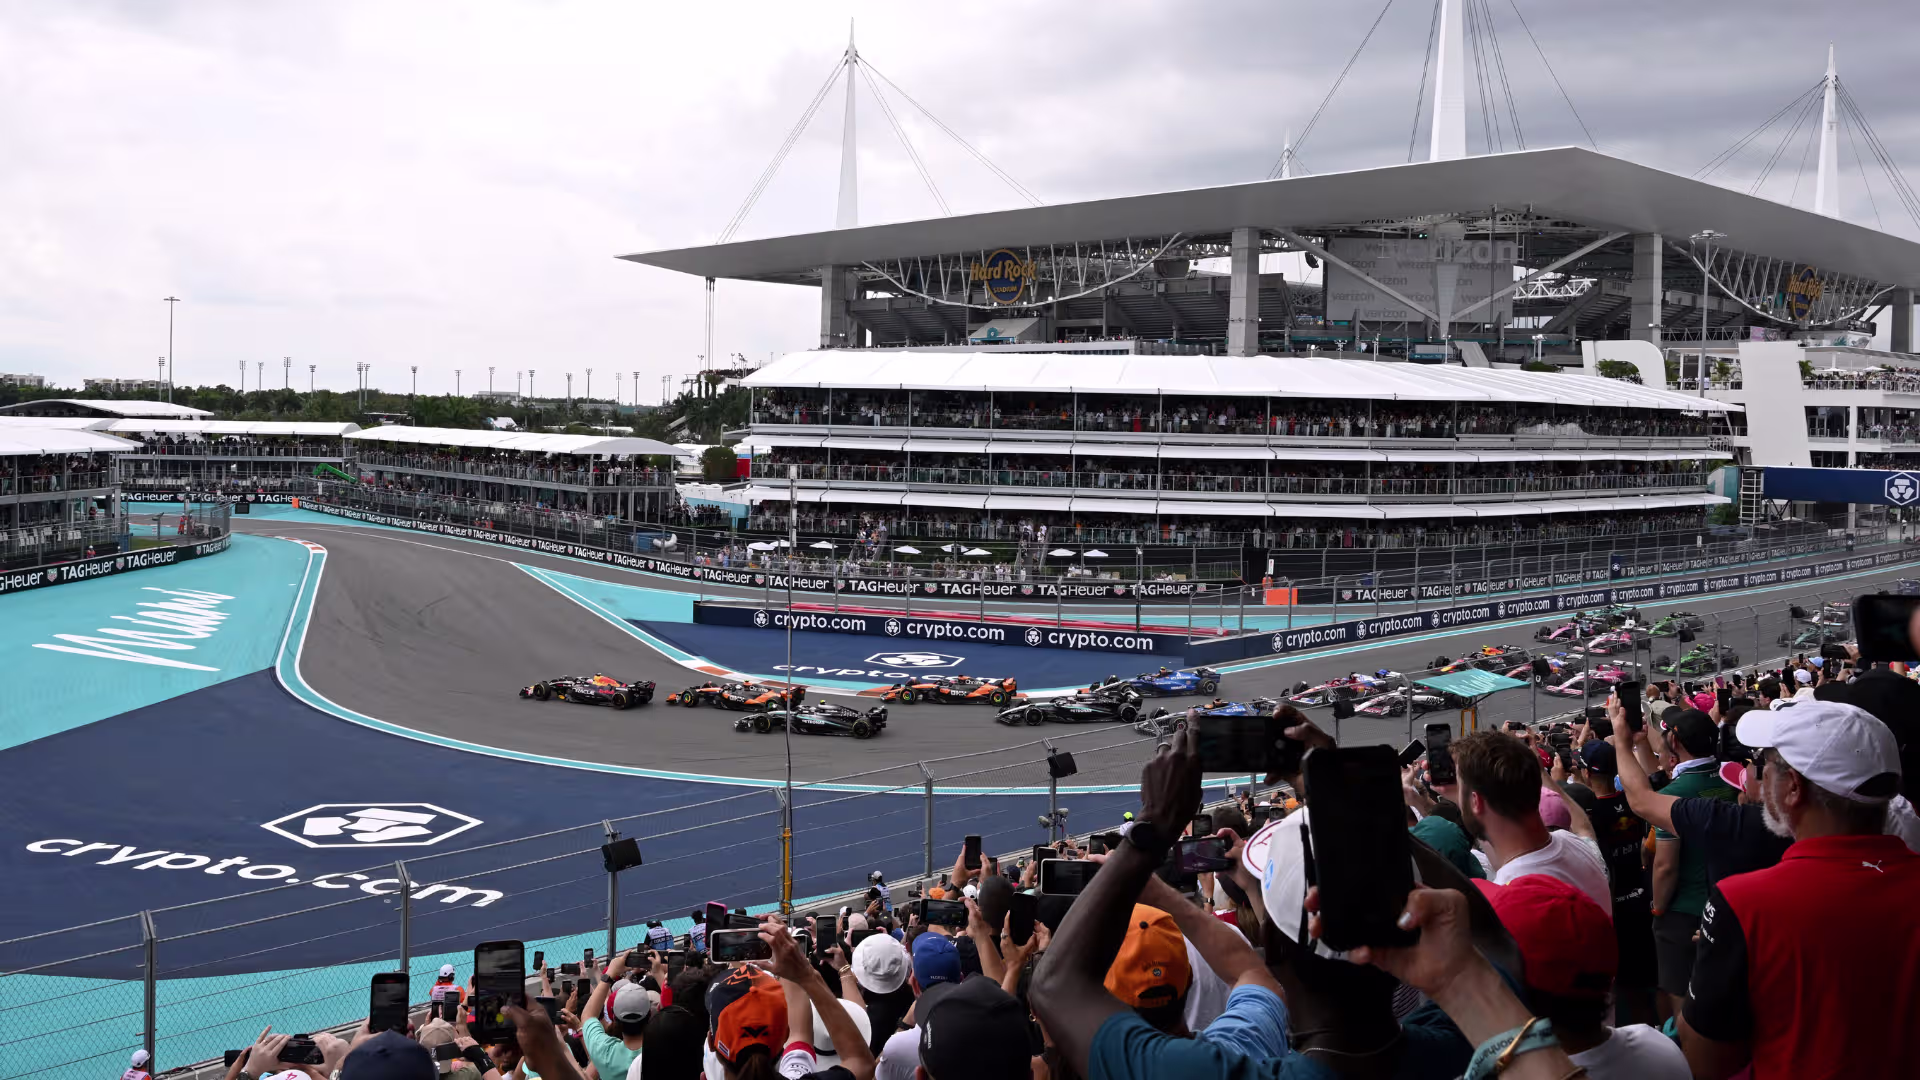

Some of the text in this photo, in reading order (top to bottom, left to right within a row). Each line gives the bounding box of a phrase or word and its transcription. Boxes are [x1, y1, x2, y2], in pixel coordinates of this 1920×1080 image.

[971, 258, 1036, 282] Hard Rock
[61, 560, 115, 581] TAGHeuer
[127, 549, 177, 568] TAGHeuer
[472, 529, 498, 542] TAGHeuer
[504, 534, 531, 548] TAGHeuer
[537, 539, 567, 554] TAGHeuer
[574, 546, 605, 561] TAGHeuer
[613, 553, 646, 568] TAGHeuer
[656, 560, 692, 577] TAGHeuer
[703, 568, 752, 584] TAGHeuer
[849, 580, 920, 593] TAGHeuer
[941, 583, 1017, 596] TAGHeuer
[1038, 583, 1110, 596] TAGHeuer
[774, 613, 1153, 650] crypto.com crypto.com crypto.com
[1286, 627, 1346, 647] crypto.com
[1369, 615, 1422, 635] crypto.com
[1442, 606, 1490, 623] crypto.com
[1508, 598, 1550, 614] crypto.com
[1566, 591, 1604, 607] crypto.com
[1619, 586, 1654, 602] crypto.com
[1666, 581, 1699, 595] crypto.com
[1710, 576, 1740, 589] crypto.com
[1750, 571, 1777, 584] crypto.com
[25, 838, 504, 907] crypto.com
